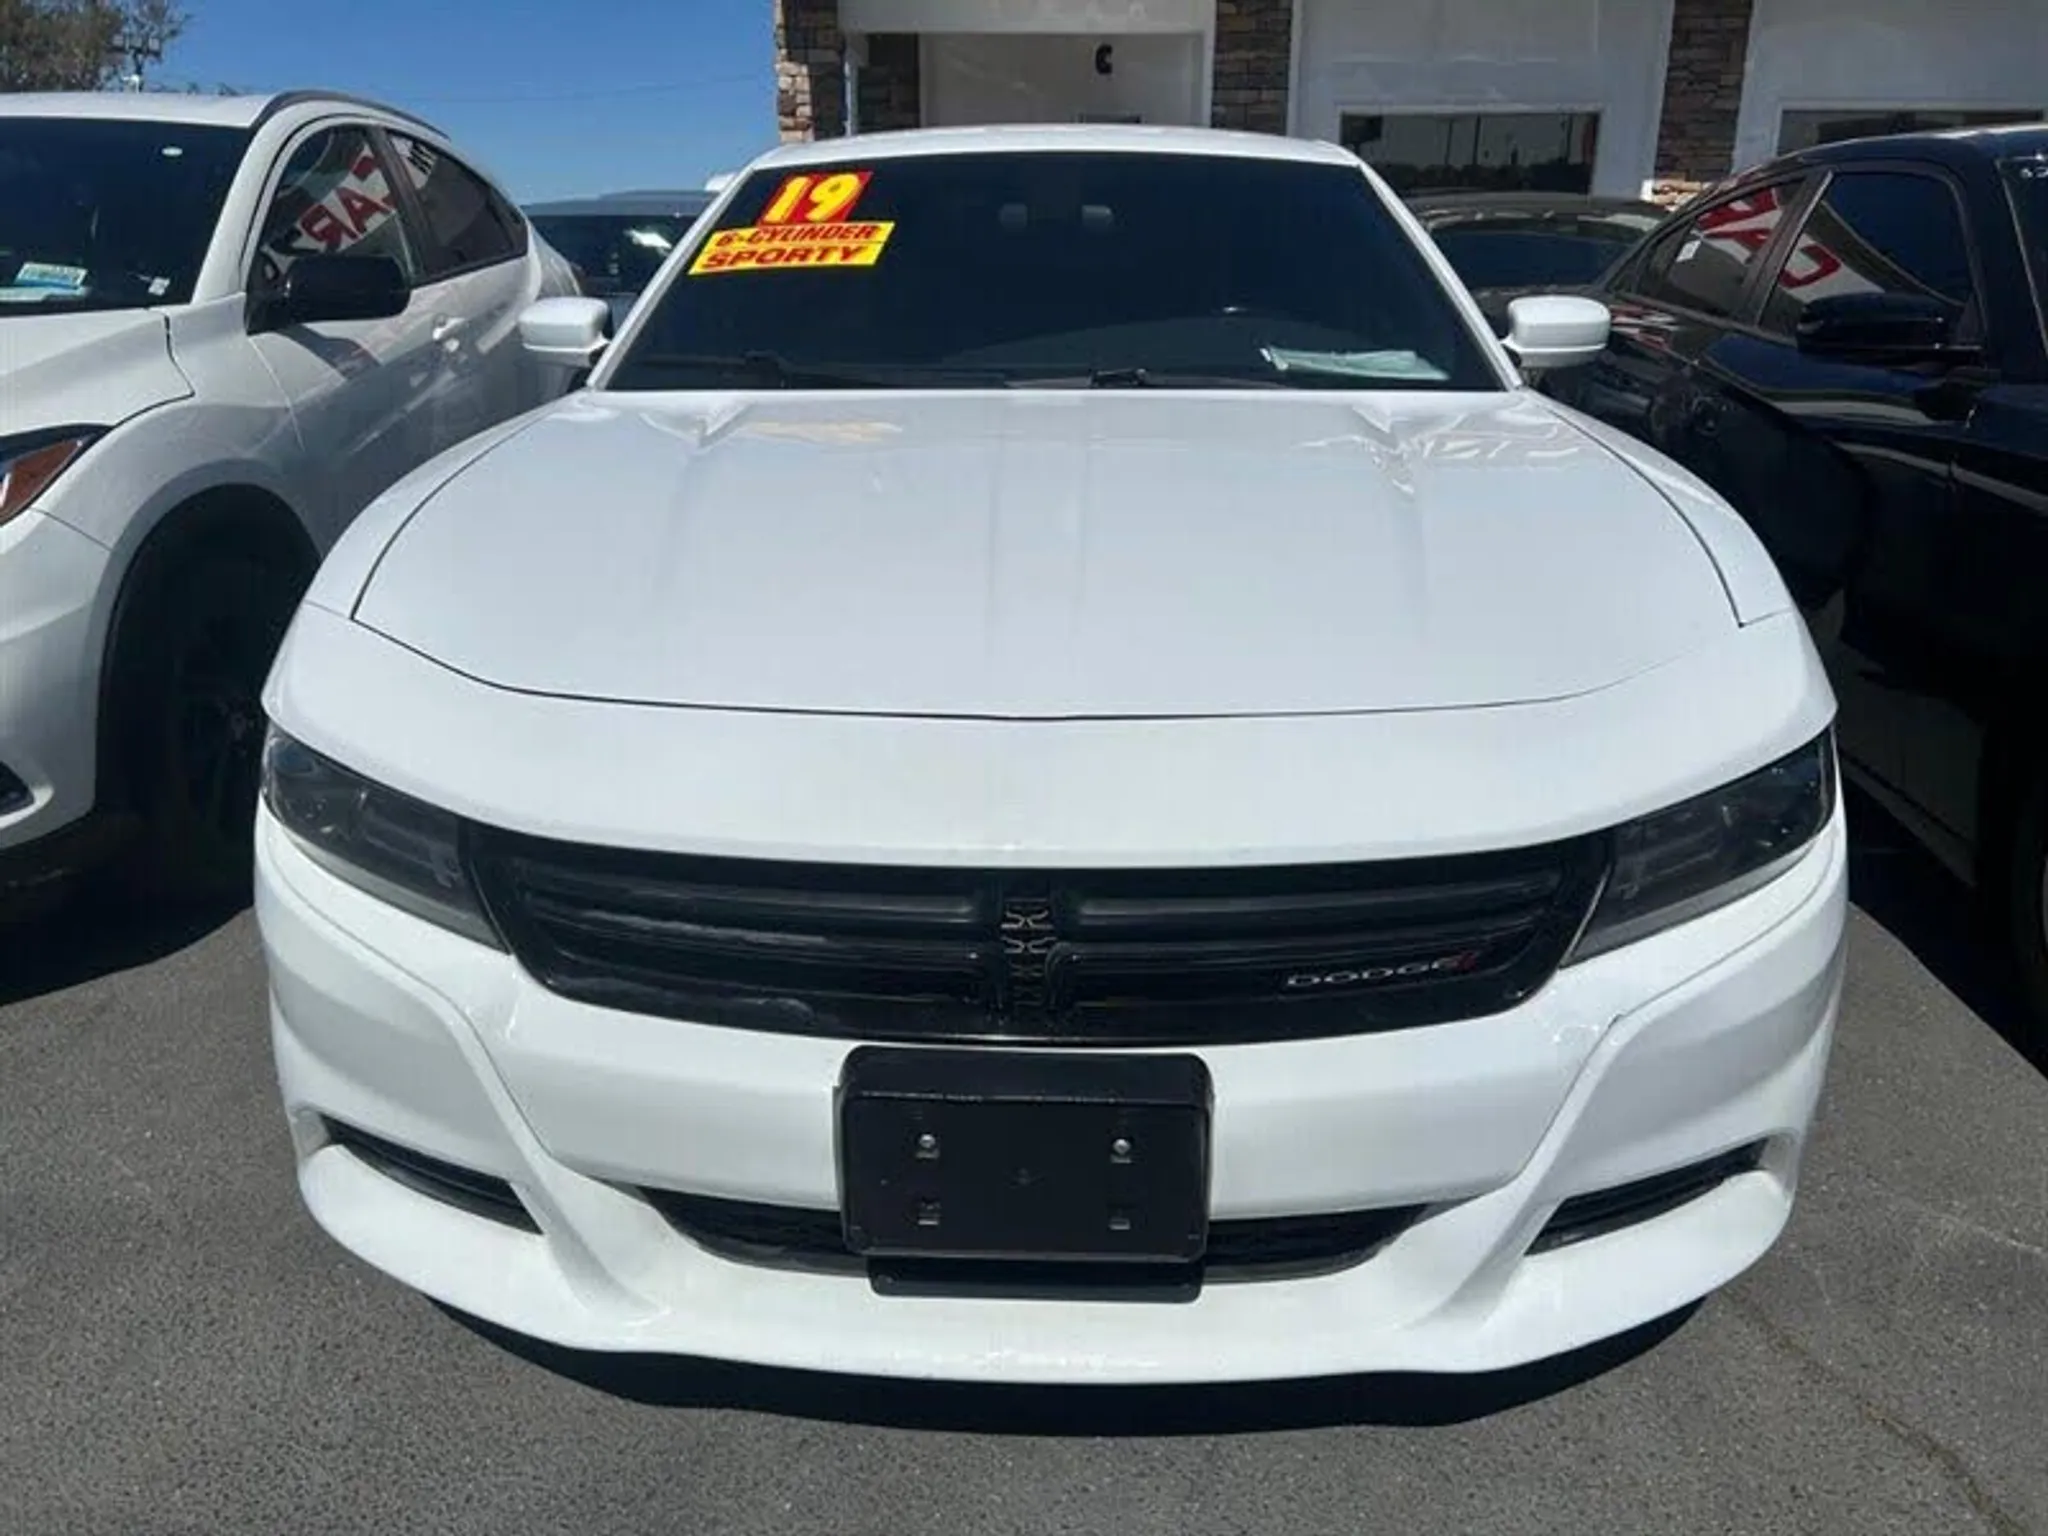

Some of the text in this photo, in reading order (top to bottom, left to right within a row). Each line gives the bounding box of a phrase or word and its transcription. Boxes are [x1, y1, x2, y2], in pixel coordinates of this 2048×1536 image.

[762, 172, 861, 224] 19
[701, 246, 868, 269] SPORTY
[1287, 955, 1460, 987] DODGE
